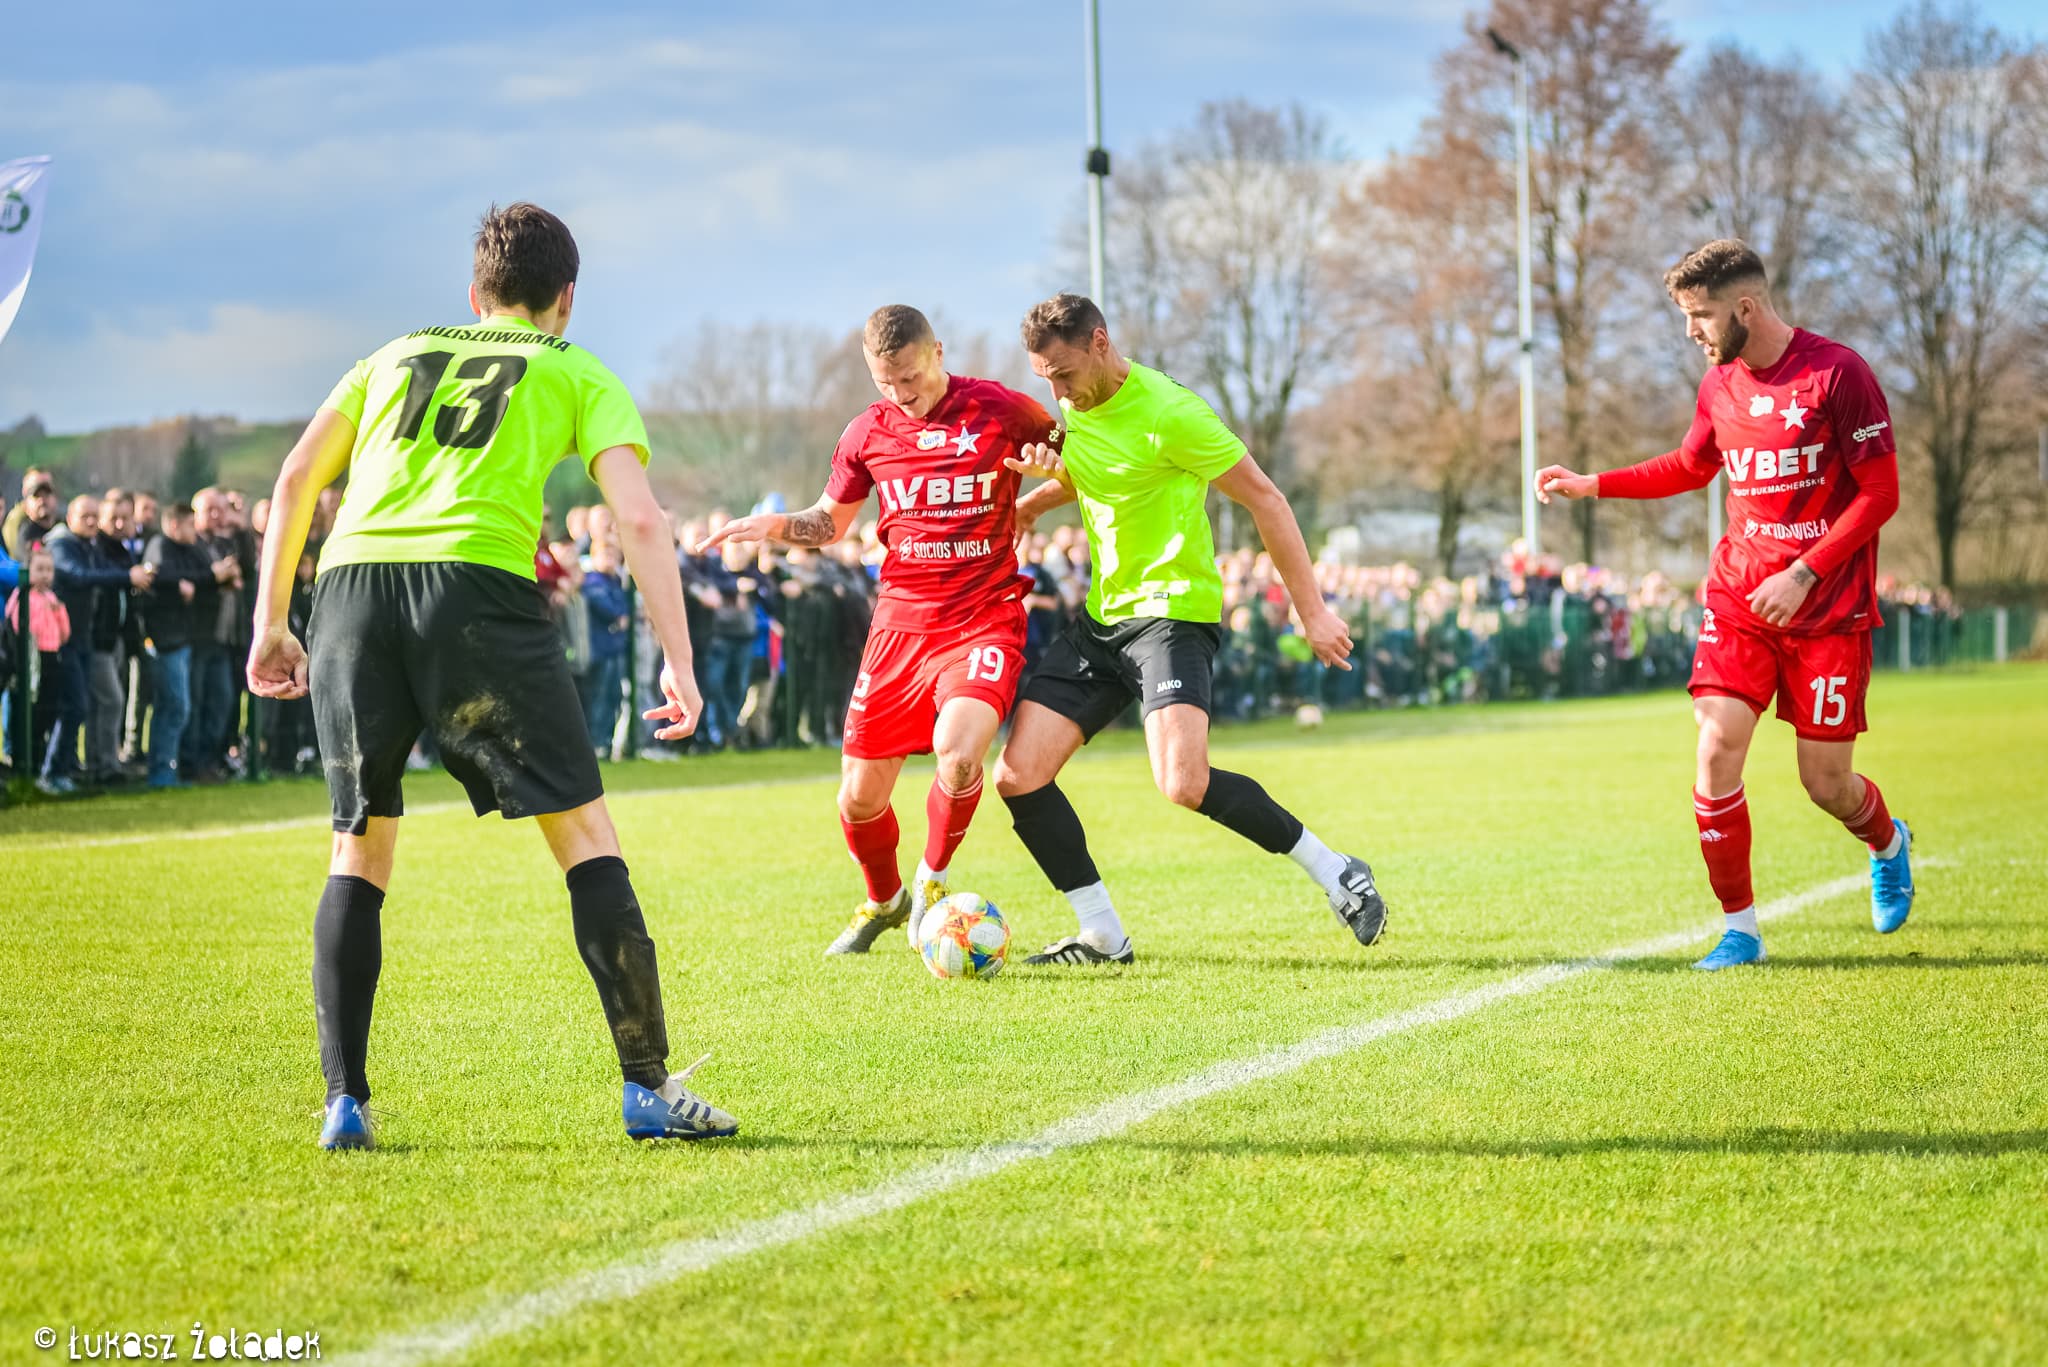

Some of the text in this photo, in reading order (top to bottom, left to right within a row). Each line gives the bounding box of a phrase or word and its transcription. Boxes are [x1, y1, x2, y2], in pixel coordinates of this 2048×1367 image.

[392, 350, 528, 449] 13
[913, 538, 991, 559] SOCIOS WISŁA
[966, 646, 1005, 682] 19
[1157, 679, 1182, 693] JAKO
[1809, 675, 1847, 726] 15
